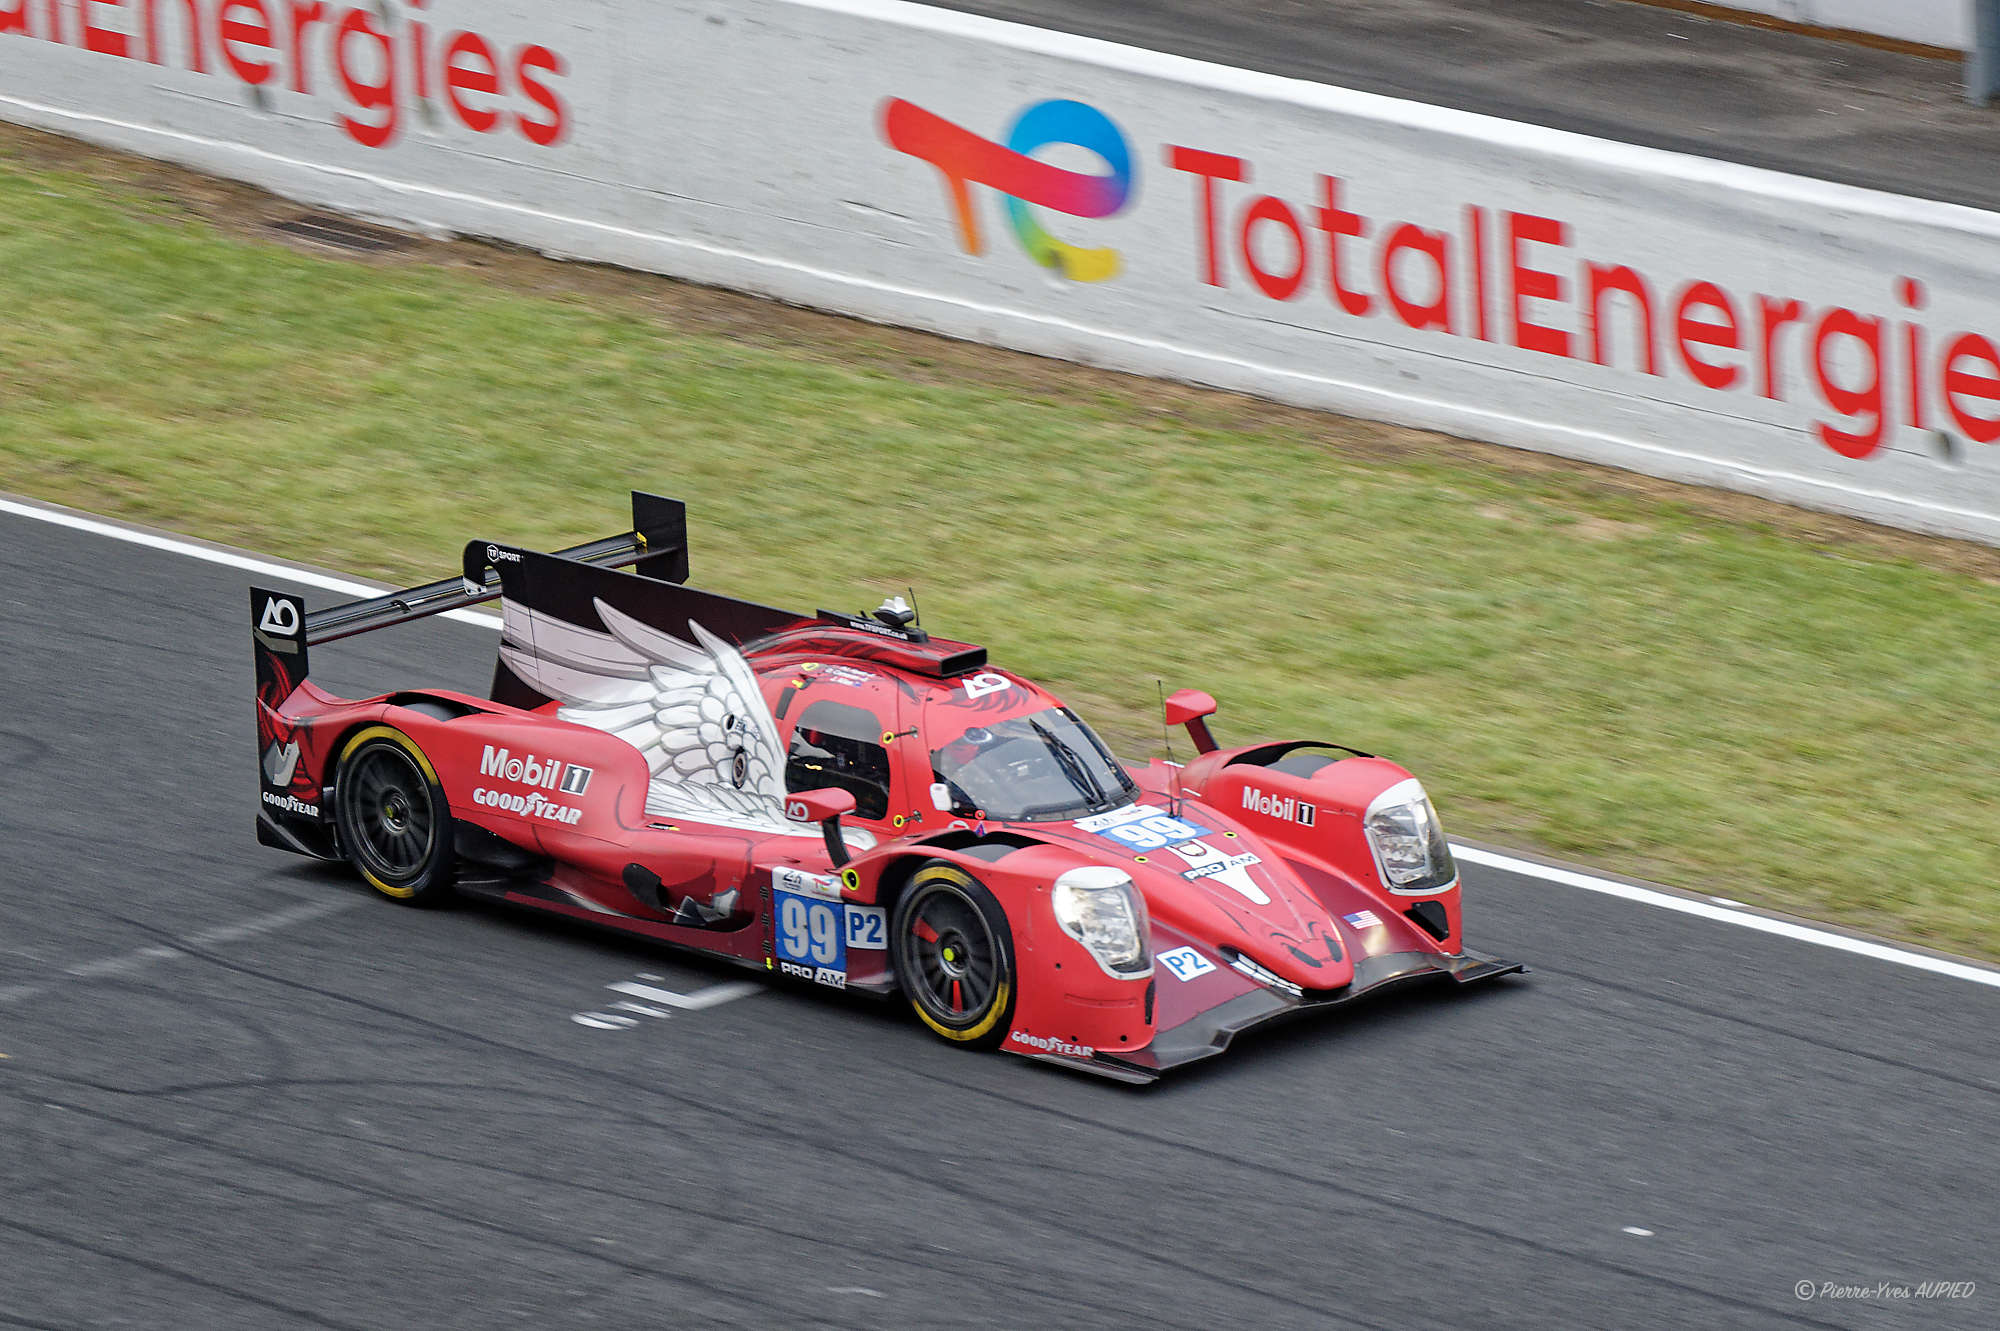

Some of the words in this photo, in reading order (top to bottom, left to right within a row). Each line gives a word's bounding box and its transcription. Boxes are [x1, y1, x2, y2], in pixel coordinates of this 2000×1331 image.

[499, 551, 521, 563] SPORT
[480, 744, 561, 791] Mobil
[262, 791, 320, 818] GOODYEAR
[473, 787, 583, 825] GOODYEAR
[1241, 785, 1295, 822] Mobil
[1111, 815, 1198, 848] 99
[1183, 863, 1225, 880] PRO
[1230, 855, 1257, 867] AM
[782, 897, 838, 965] 99
[848, 911, 883, 943] P2
[780, 961, 814, 980] PRO
[819, 970, 845, 988] AM
[1165, 951, 1209, 976] P2
[1011, 1030, 1095, 1057] GOODYEAR
